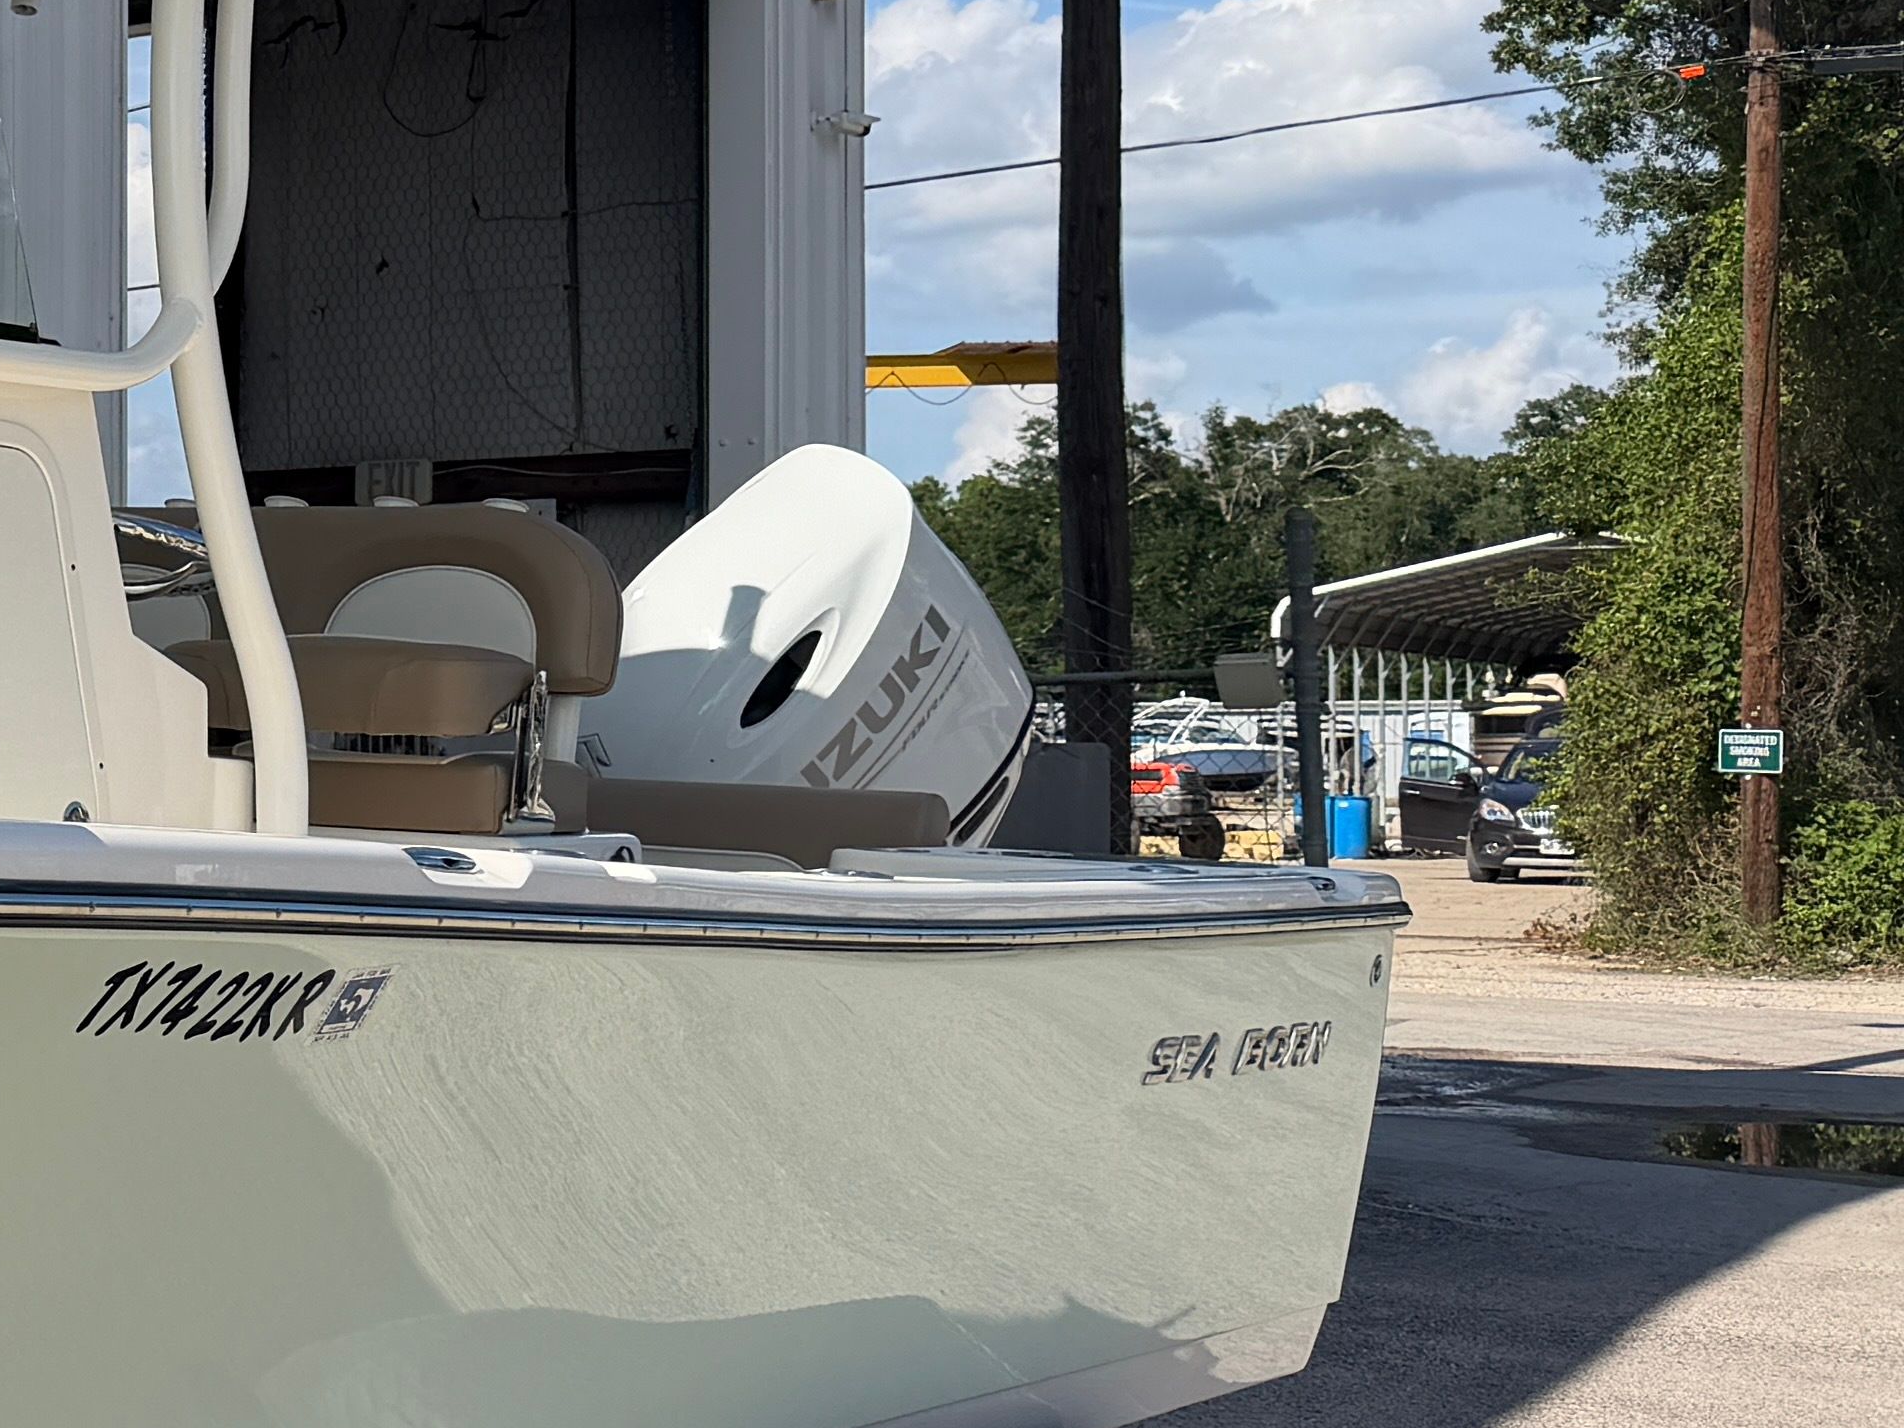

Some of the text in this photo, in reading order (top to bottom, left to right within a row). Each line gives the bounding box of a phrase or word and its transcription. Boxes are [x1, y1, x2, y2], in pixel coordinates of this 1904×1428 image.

[368, 461, 421, 505] EXIT
[799, 603, 951, 788] ZUKI
[1723, 734, 1778, 746] DESIGNATED
[1729, 746, 1770, 757] SMOKING
[1736, 757, 1761, 768] AREA
[1141, 1031, 1221, 1085] SEA
